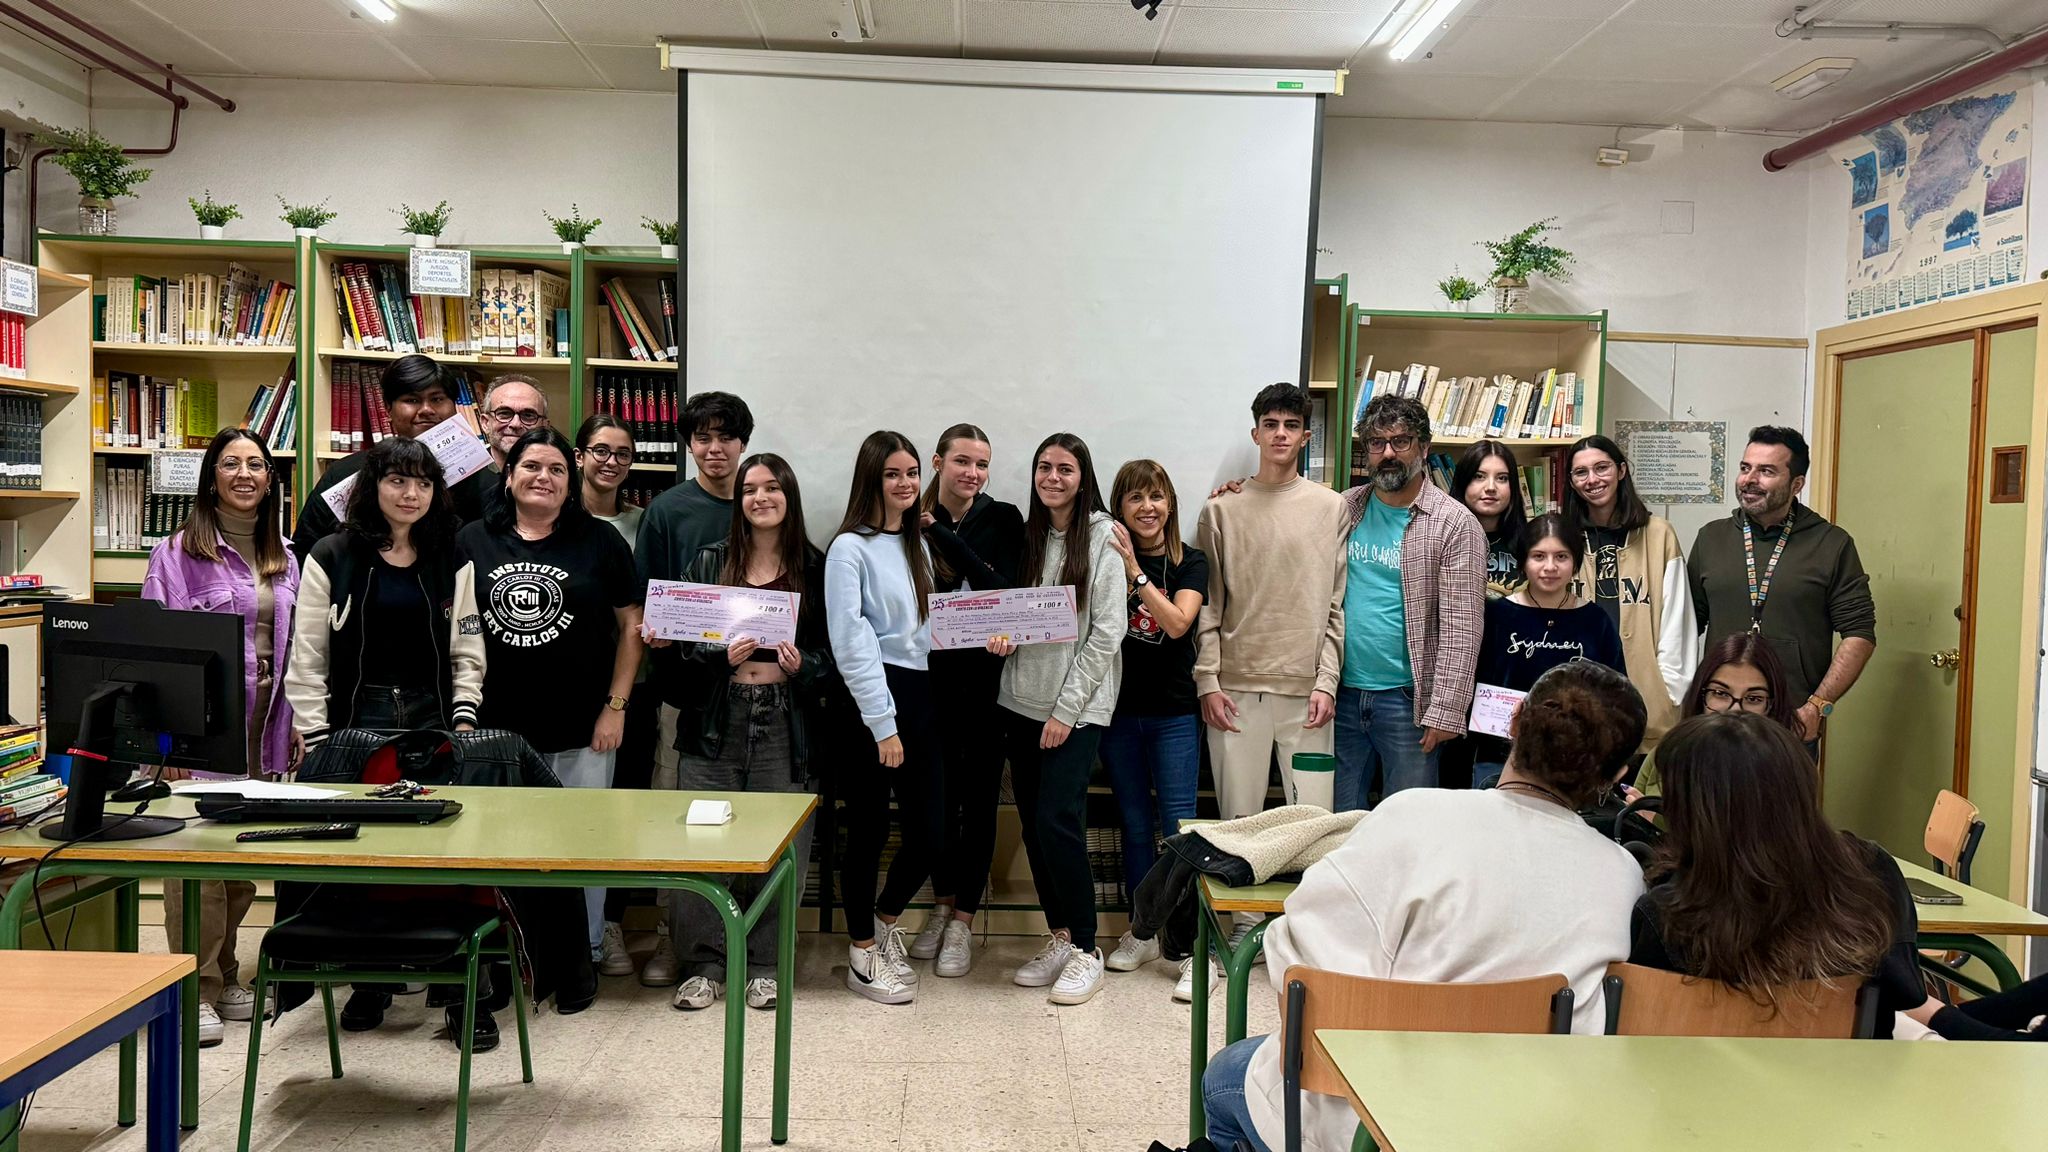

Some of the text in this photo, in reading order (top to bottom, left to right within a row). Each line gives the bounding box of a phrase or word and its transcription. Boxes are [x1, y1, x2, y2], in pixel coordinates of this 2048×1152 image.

[1920, 255, 1937, 267] 1997
[441, 437, 451, 447] 50
[143, 503, 151, 532] HISTORIA
[156, 504, 164, 532] HISTORIA
[165, 503, 174, 531] HISTORIA
[487, 562, 569, 581] INSTITUTO
[498, 580, 507, 591] REY
[506, 575, 533, 583] CARLOS
[651, 585, 664, 598] 25
[764, 605, 778, 613] 100
[931, 598, 945, 611] 25
[1043, 601, 1056, 609] 100
[52, 616, 89, 630] Lenovo
[483, 609, 503, 635] REY
[501, 626, 560, 647] CARLOS
[557, 611, 574, 630] III
[1507, 631, 1583, 663] Sydney
[1479, 689, 1492, 700] 25
